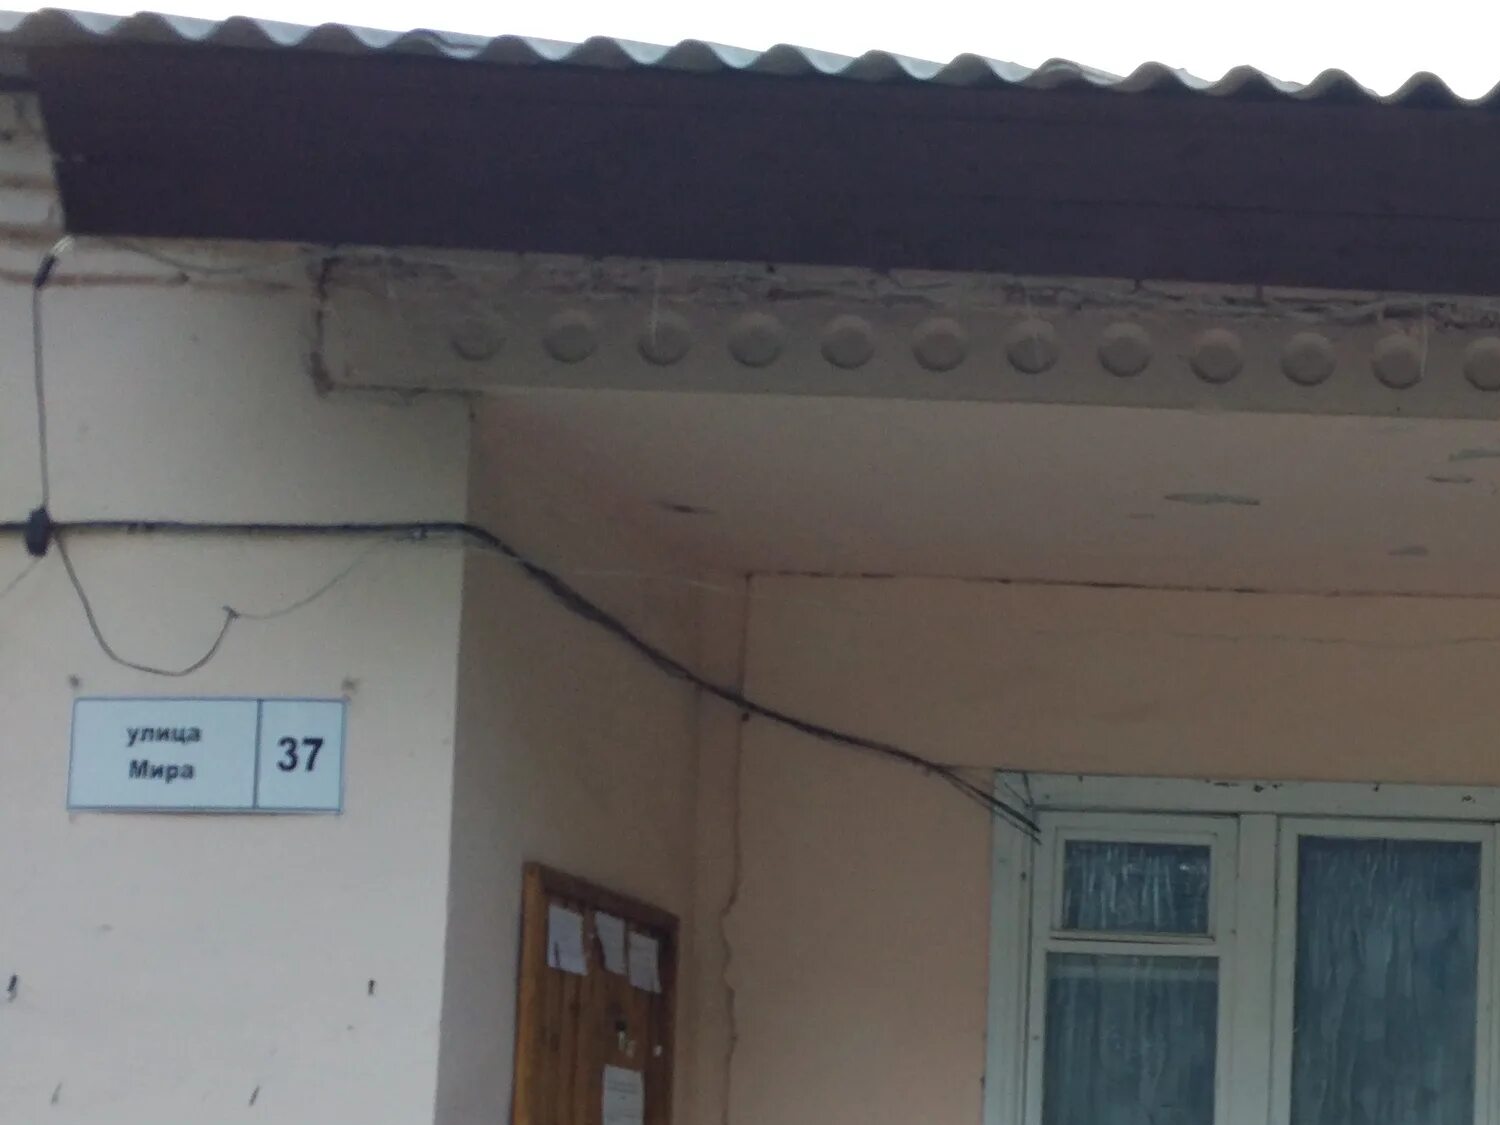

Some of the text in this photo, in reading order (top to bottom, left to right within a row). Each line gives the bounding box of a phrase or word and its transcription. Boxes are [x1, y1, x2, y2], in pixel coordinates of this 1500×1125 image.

[126, 726, 201, 747] улица
[277, 737, 324, 772] 37
[128, 760, 195, 784] Мира
